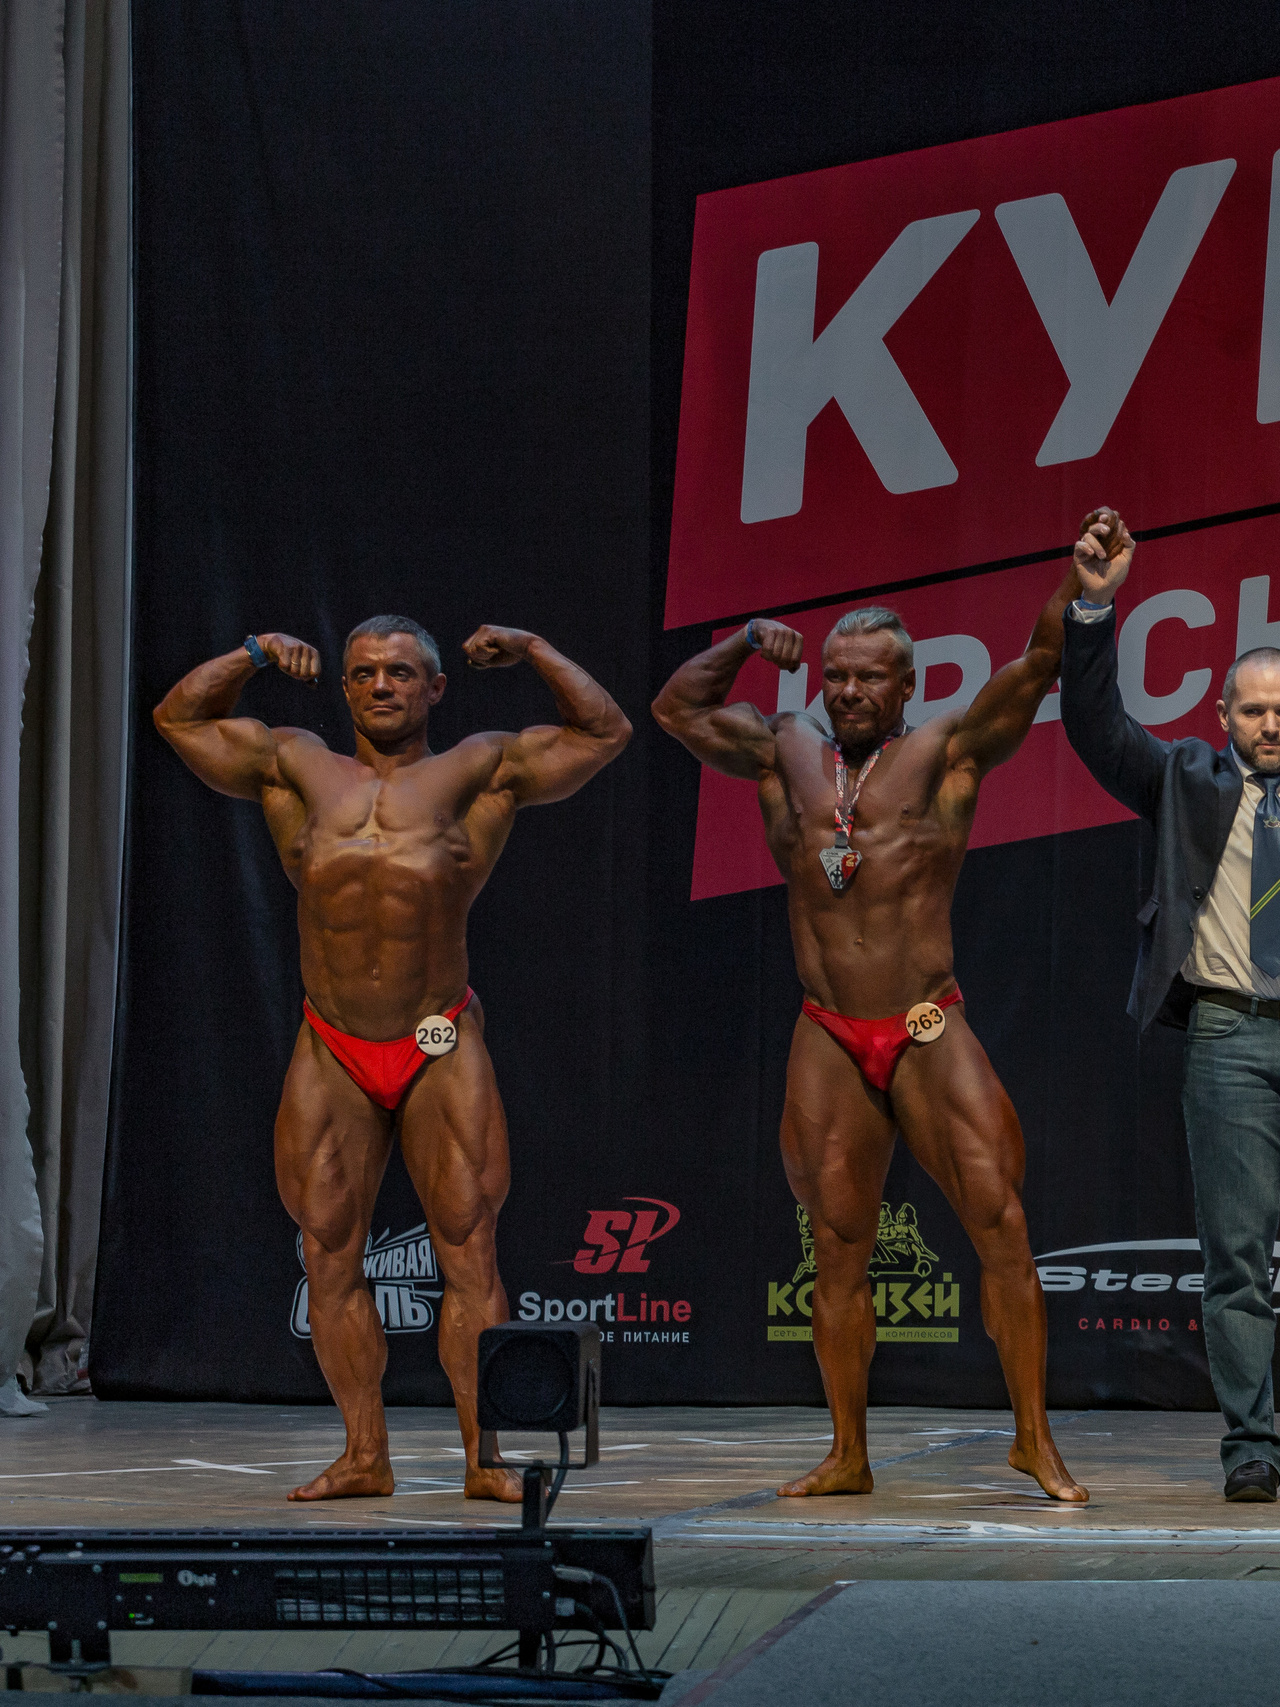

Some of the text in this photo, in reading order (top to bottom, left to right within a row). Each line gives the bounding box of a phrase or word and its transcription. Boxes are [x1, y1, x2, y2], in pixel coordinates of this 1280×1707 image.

[908, 1008, 943, 1037] 263
[418, 1026, 455, 1045] 262
[767, 1272, 960, 1325] КОИЗЕЙ
[518, 1291, 692, 1323] SportLine
[1078, 1318, 1199, 1332] CARDIO &
[623, 1331, 690, 1343] ПИТАНИЕ
[773, 1330, 798, 1338] сеть
[885, 1331, 953, 1339] комплексов
